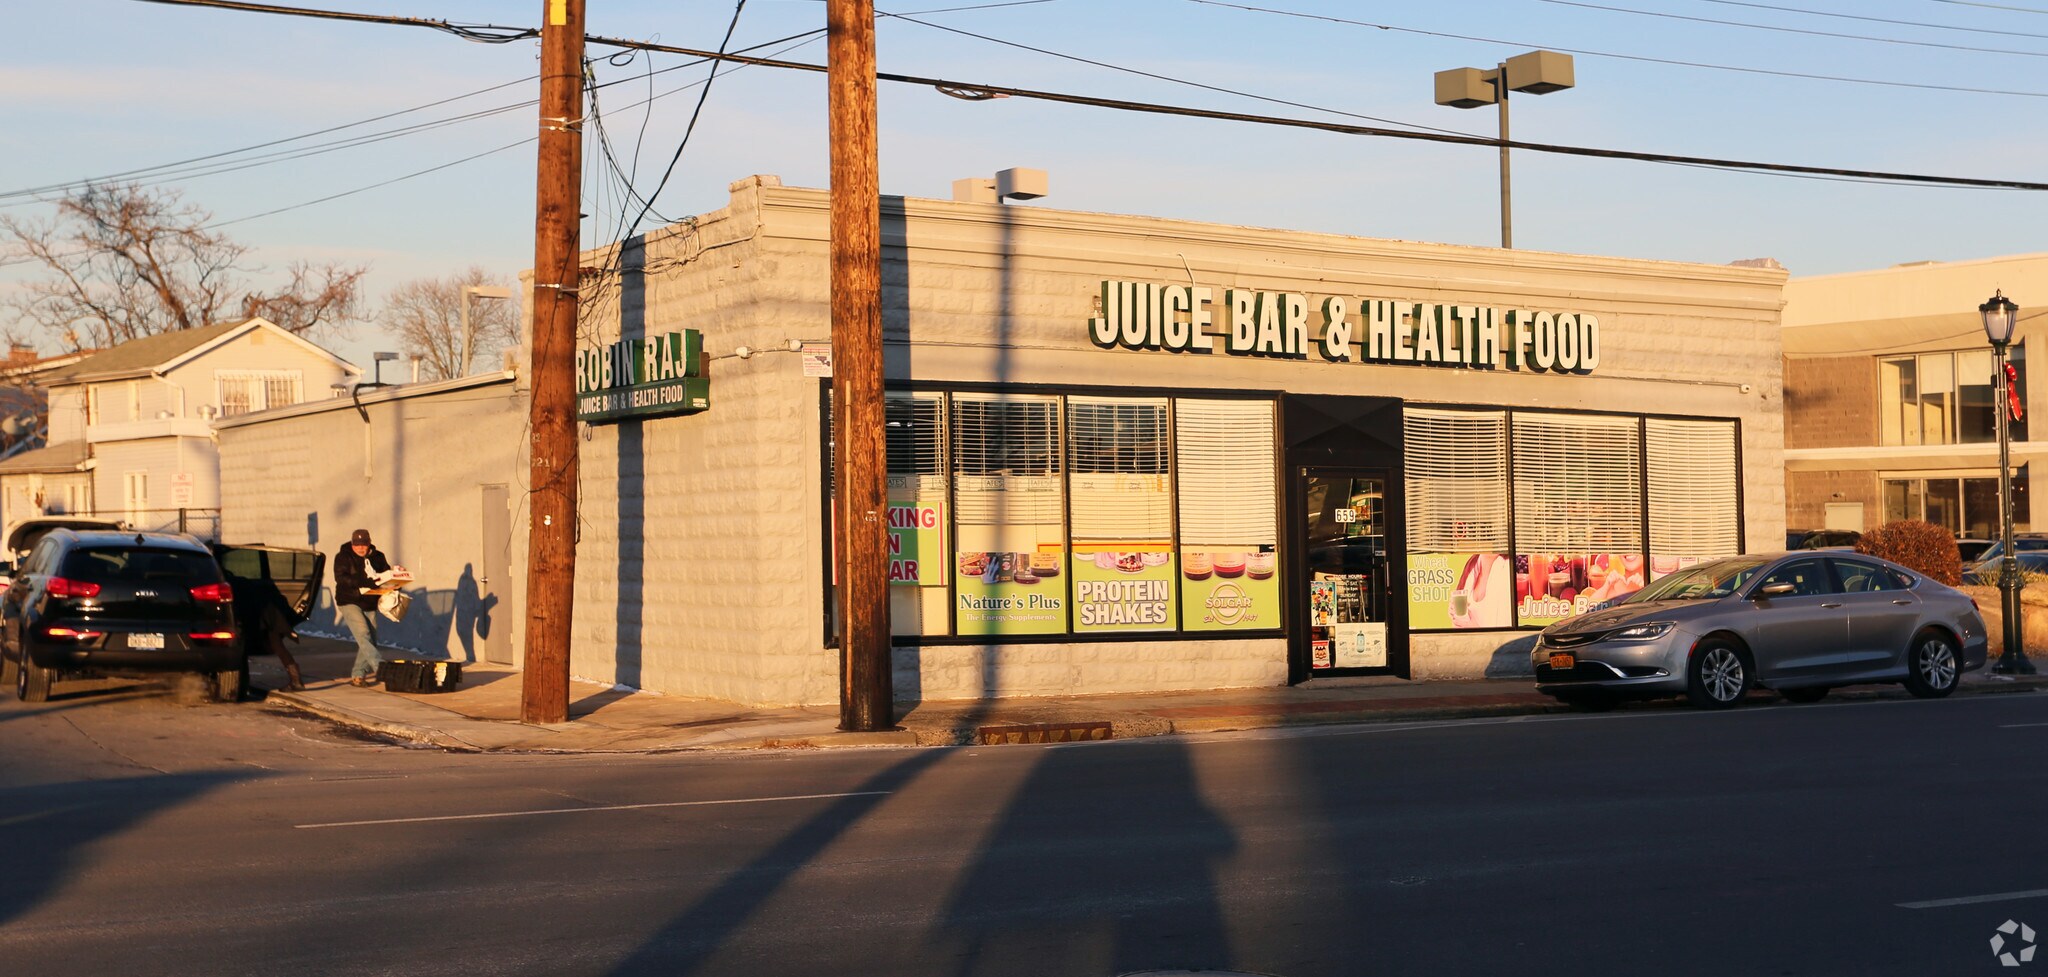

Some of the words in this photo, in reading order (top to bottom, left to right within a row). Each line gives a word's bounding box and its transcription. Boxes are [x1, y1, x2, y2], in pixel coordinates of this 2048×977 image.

[1092, 280, 1213, 350] JUICE
[1230, 289, 1308, 356] BAR
[1325, 296, 1353, 358] &
[1366, 299, 1500, 365] HEALTH
[1513, 309, 1600, 371] FOOD
[575, 339, 635, 394] ROBIN
[644, 328, 687, 383] RAJ
[579, 395, 601, 415] JUICE
[602, 393, 618, 412] BAR
[620, 392, 627, 409] &
[628, 387, 658, 409] HEALTH
[660, 384, 683, 405] FOOD
[887, 507, 936, 529] KING
[1336, 509, 1354, 521] 659
[1414, 556, 1447, 568] Wheat
[1408, 569, 1454, 585] GRASS
[1077, 580, 1169, 602] PROTEIN
[1413, 586, 1450, 602] SHOT
[960, 594, 1024, 609] Nature's
[1029, 594, 1060, 609] Plus
[1206, 598, 1252, 608] SOLGAR
[1520, 597, 1570, 617] Juice
[966, 613, 979, 621] The
[981, 614, 1007, 622] Energy
[1009, 613, 1056, 621] Supplements
[1081, 602, 1168, 625] SHAKES
